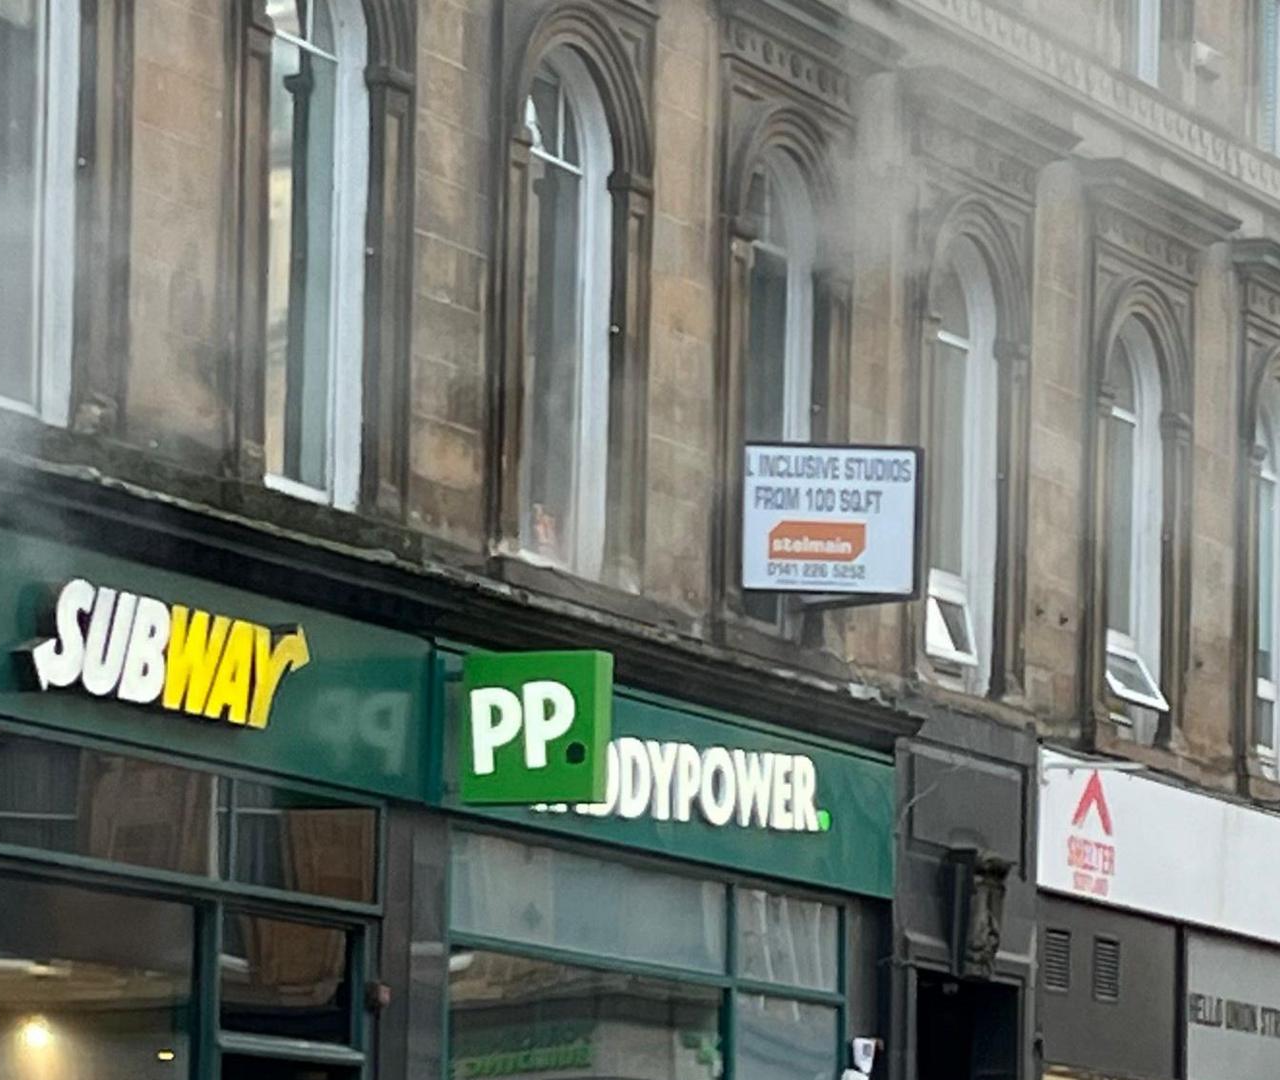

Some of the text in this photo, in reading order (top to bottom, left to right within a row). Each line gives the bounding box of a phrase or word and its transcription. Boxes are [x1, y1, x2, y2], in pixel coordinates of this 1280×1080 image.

[759, 455, 840, 480] INCLUSIVE
[844, 458, 911, 482] STUDIOS
[754, 486, 800, 511] FROM
[806, 488, 836, 512] 100
[33, 578, 310, 729] SUBWAY
